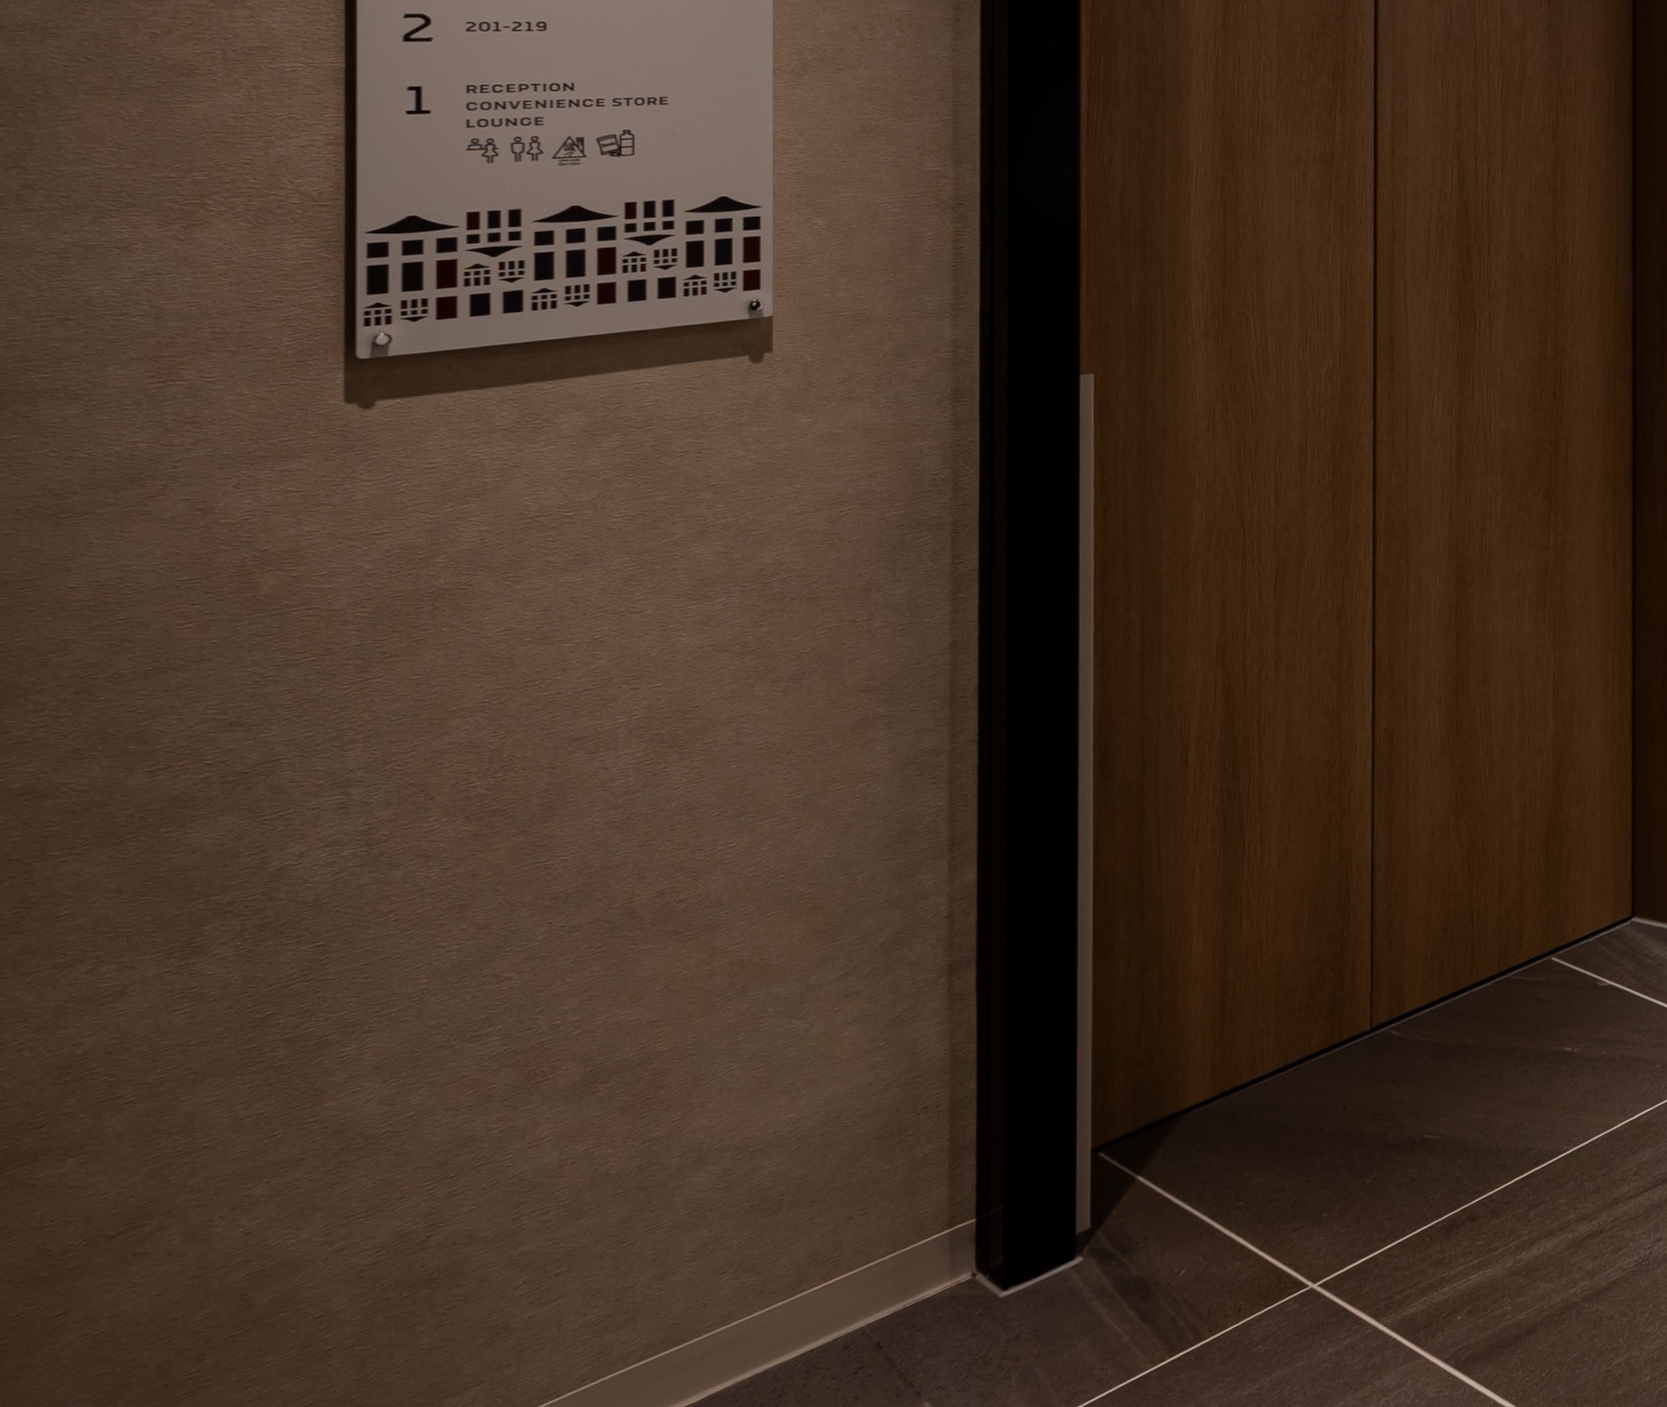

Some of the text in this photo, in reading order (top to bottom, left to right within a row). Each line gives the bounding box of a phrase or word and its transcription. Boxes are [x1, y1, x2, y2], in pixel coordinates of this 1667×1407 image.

[402, 13, 548, 43] 2 201-219
[465, 82, 575, 94] RECEPTION
[405, 85, 432, 115] 1
[465, 95, 669, 112] CONVENIENCE STORE
[465, 116, 545, 129] LOUNGE
